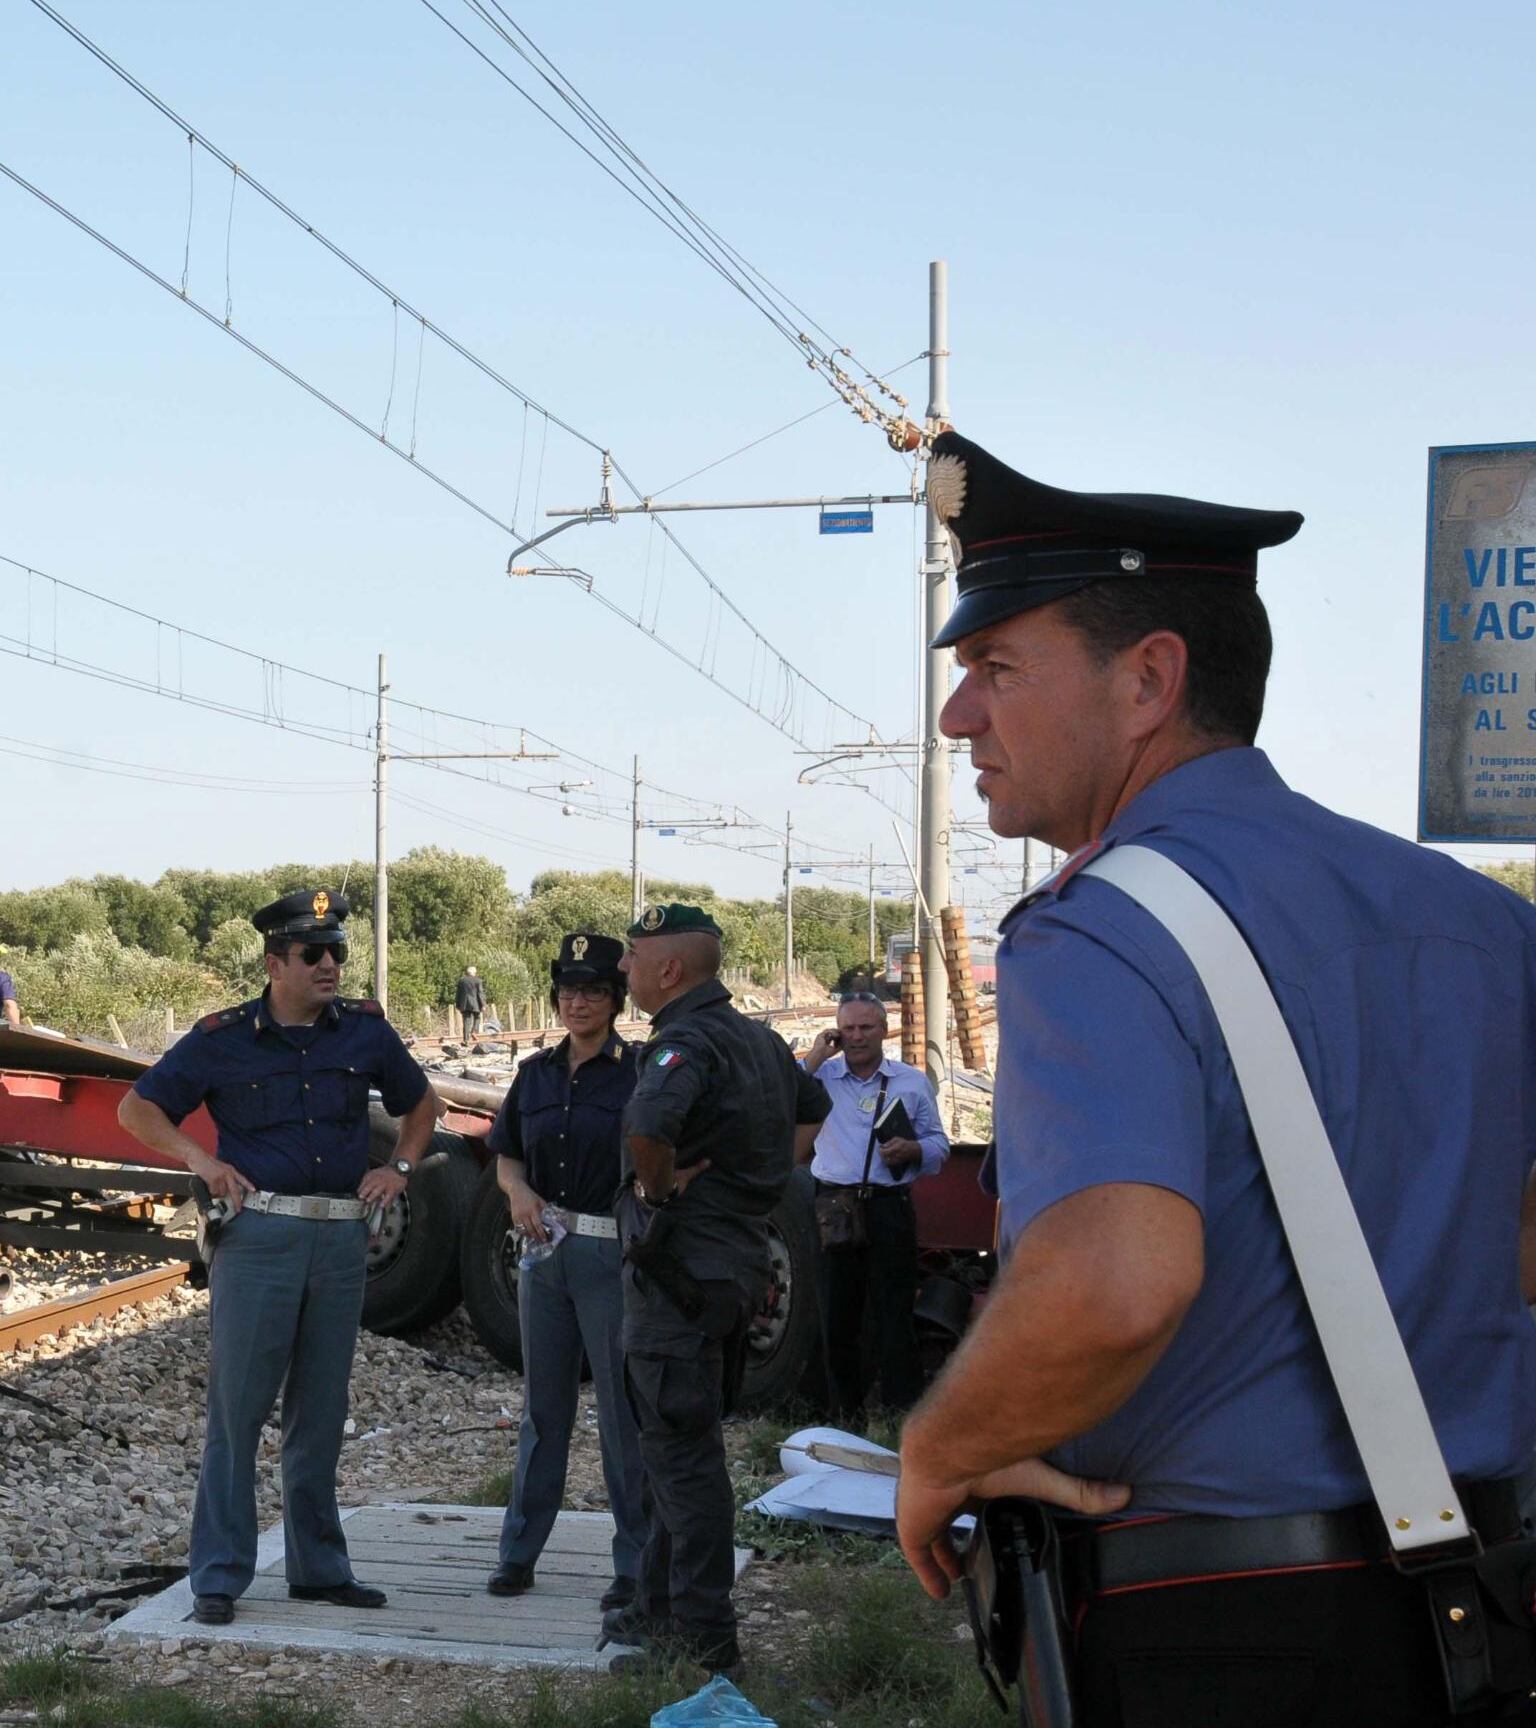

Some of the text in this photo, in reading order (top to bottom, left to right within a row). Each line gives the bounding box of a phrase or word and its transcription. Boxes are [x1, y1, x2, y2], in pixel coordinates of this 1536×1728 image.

[1464, 547, 1536, 587] VIE
[1440, 601, 1536, 641] L'AC
[1462, 672, 1518, 694] AGLI
[1475, 709, 1506, 731] AL
[1475, 771, 1495, 782] alla
